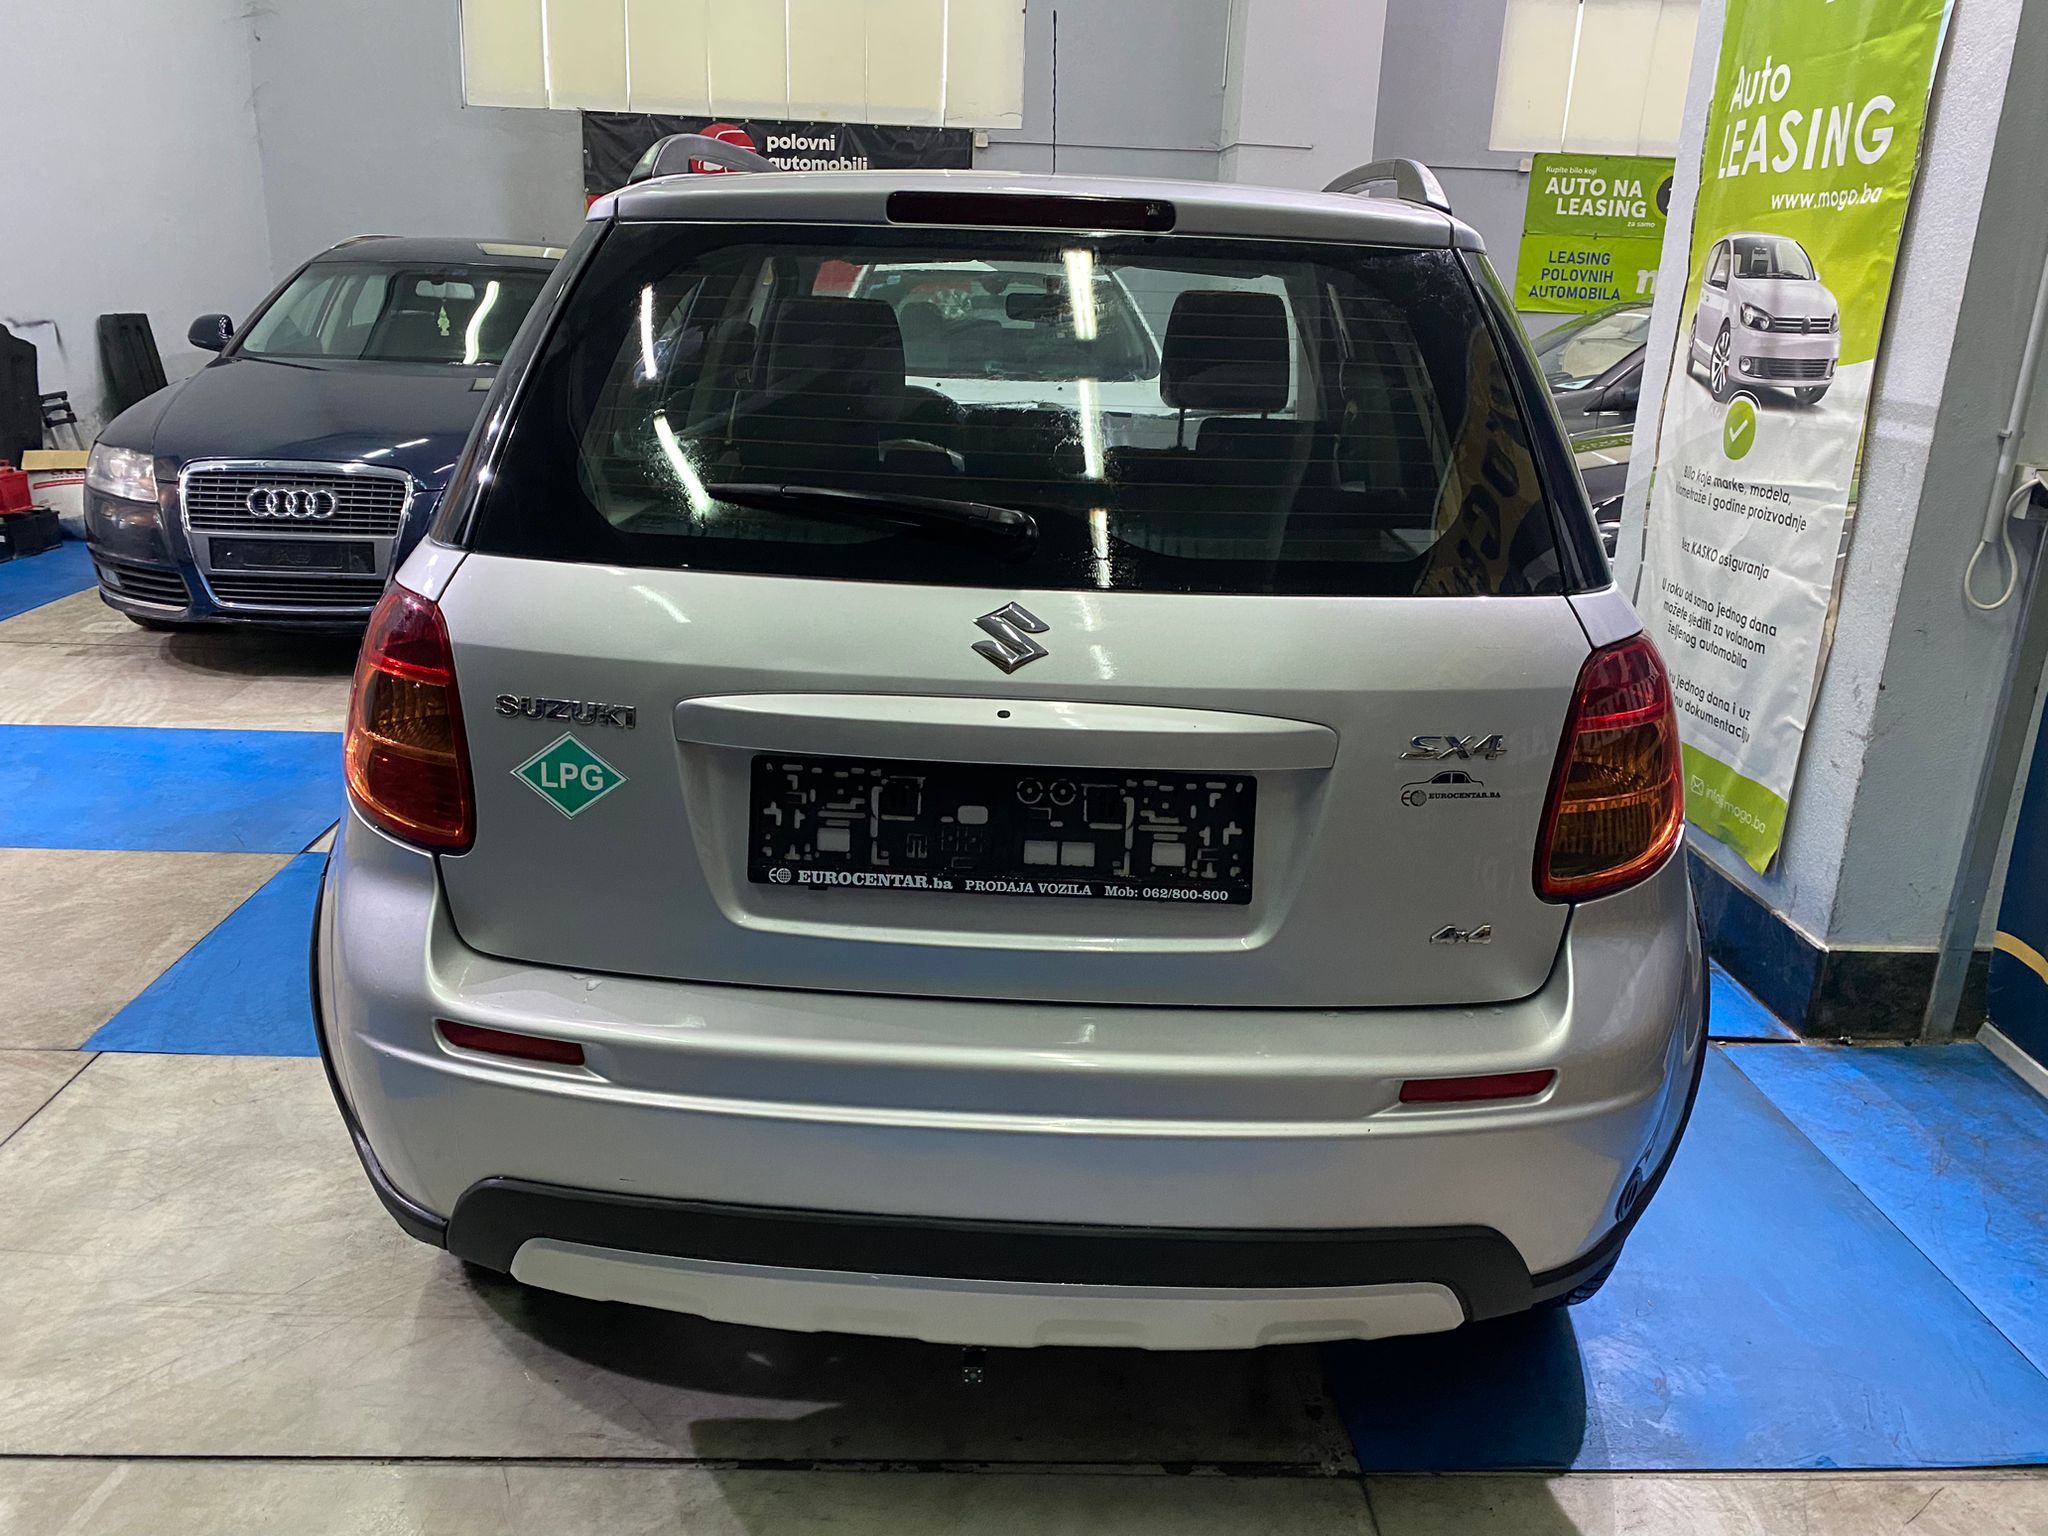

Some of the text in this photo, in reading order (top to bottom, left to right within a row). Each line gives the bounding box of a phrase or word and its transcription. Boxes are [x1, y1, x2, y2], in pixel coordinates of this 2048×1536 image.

[1730, 55, 1791, 113] Auto
[766, 133, 836, 152] polovni
[1718, 95, 1896, 179] LEASING
[768, 155, 868, 171] automobili
[1546, 166, 1598, 176] Kupite bilo koji
[1544, 177, 1643, 198] AUTO NA
[1771, 182, 1883, 212] www.mogo.ba
[1556, 198, 1647, 218] LEASING
[1549, 250, 1611, 266] LEASING
[1541, 268, 1614, 283] POLOVNIH
[1528, 285, 1620, 301] AUTOMOBILA
[1750, 485, 1791, 506] modela,
[1708, 493, 1712, 506] i
[1713, 498, 1746, 514] godine
[1747, 506, 1807, 533] proizvodnje
[1691, 542, 1718, 562] KASKO
[1719, 554, 1769, 580] osiguranja
[1667, 583, 1684, 598] roku
[1684, 590, 1693, 603] od
[1694, 596, 1714, 612] samo
[1716, 602, 1748, 628] jednog
[1749, 616, 1777, 636] dana
[1667, 620, 1747, 669] željenog automobila
[1713, 624, 1723, 636] za
[1725, 628, 1765, 654] volanom
[494, 692, 637, 730] SUZUKI
[1676, 675, 1705, 702] jednog
[1706, 691, 1730, 712] dana
[1732, 702, 1737, 715] i
[1739, 707, 1751, 721] uz
[1399, 734, 1508, 761] SX4
[540, 761, 604, 791] LPG
[1428, 791, 1501, 800] EUROCENTAR.BA
[798, 870, 1229, 901] EUROCENTAR.ba PRODAJA VOZILA Mob: 062/800-800
[1429, 924, 1491, 945] 4x4
